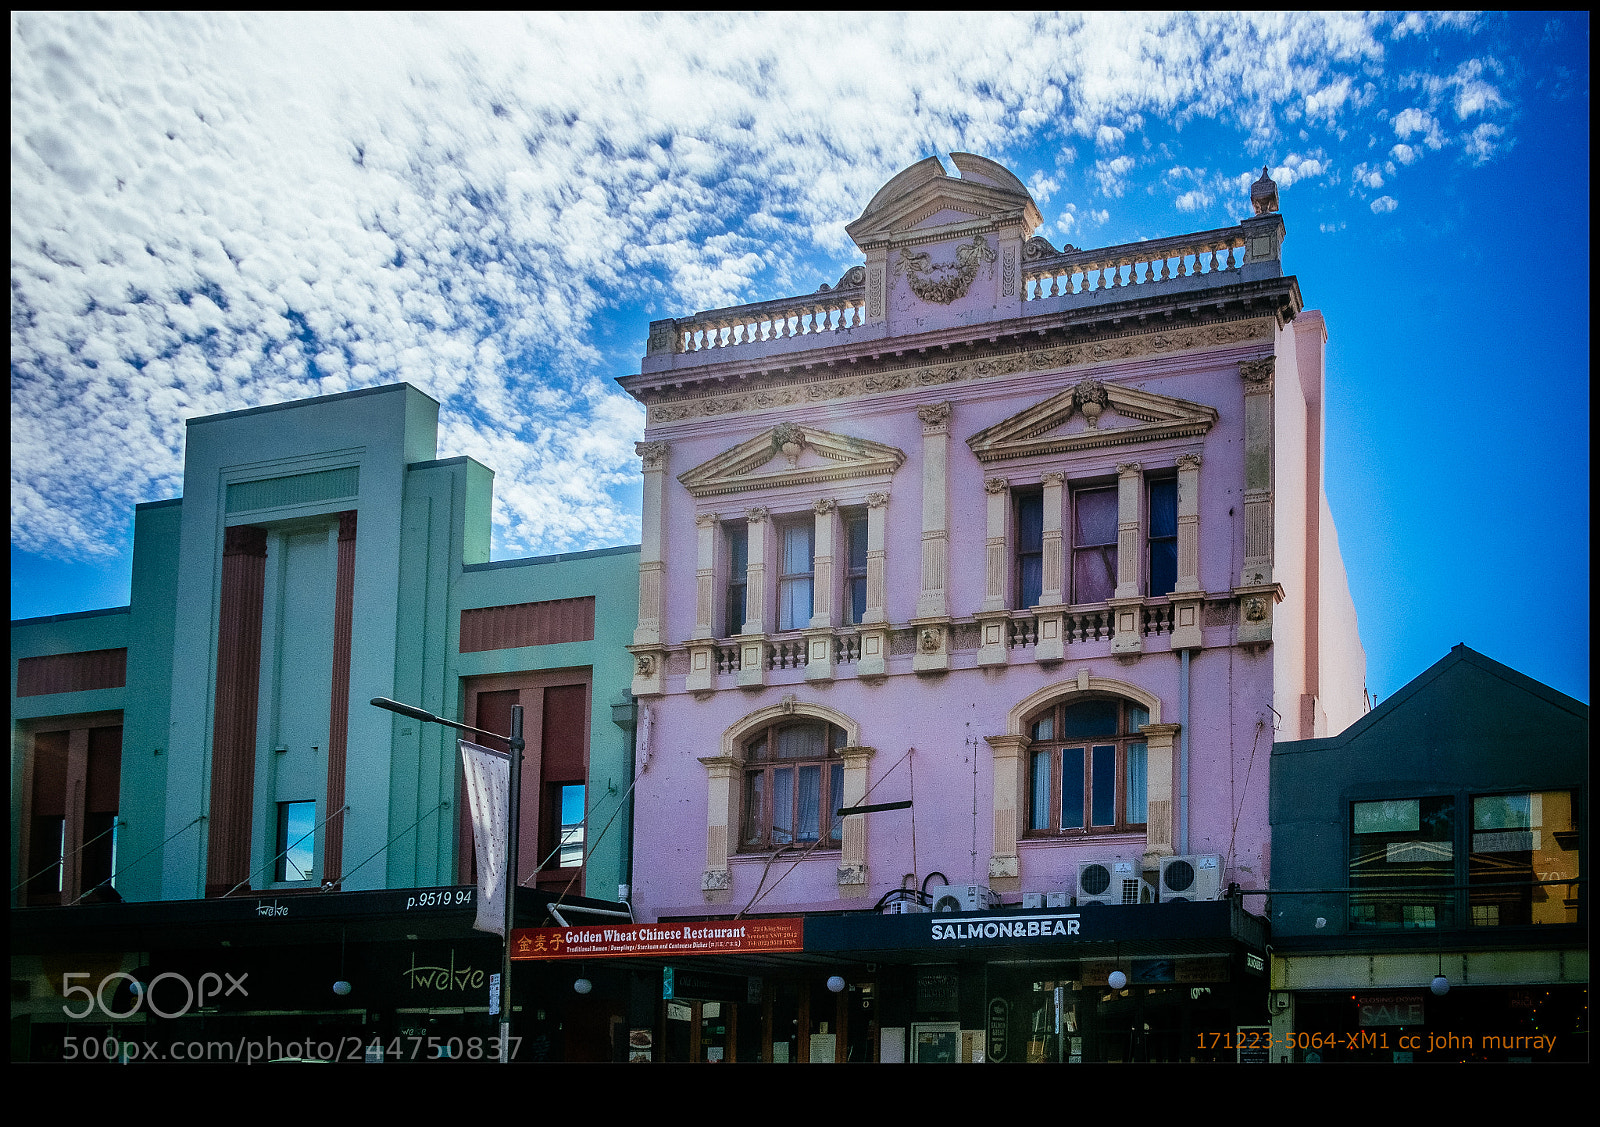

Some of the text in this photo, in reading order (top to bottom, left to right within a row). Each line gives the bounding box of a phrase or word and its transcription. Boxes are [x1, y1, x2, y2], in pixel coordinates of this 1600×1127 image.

[256, 899, 289, 916] twelve
[406, 891, 451, 910] p.9519
[565, 925, 746, 943] Golden Wheat Chinese Restaurant
[931, 919, 1081, 940] SALMON&BEAR
[517, 933, 565, 952] 金麦子
[566, 945, 592, 953] Traditional
[592, 944, 608, 952] Ramen
[403, 948, 485, 991] twelve
[1362, 1004, 1421, 1024] SALE
